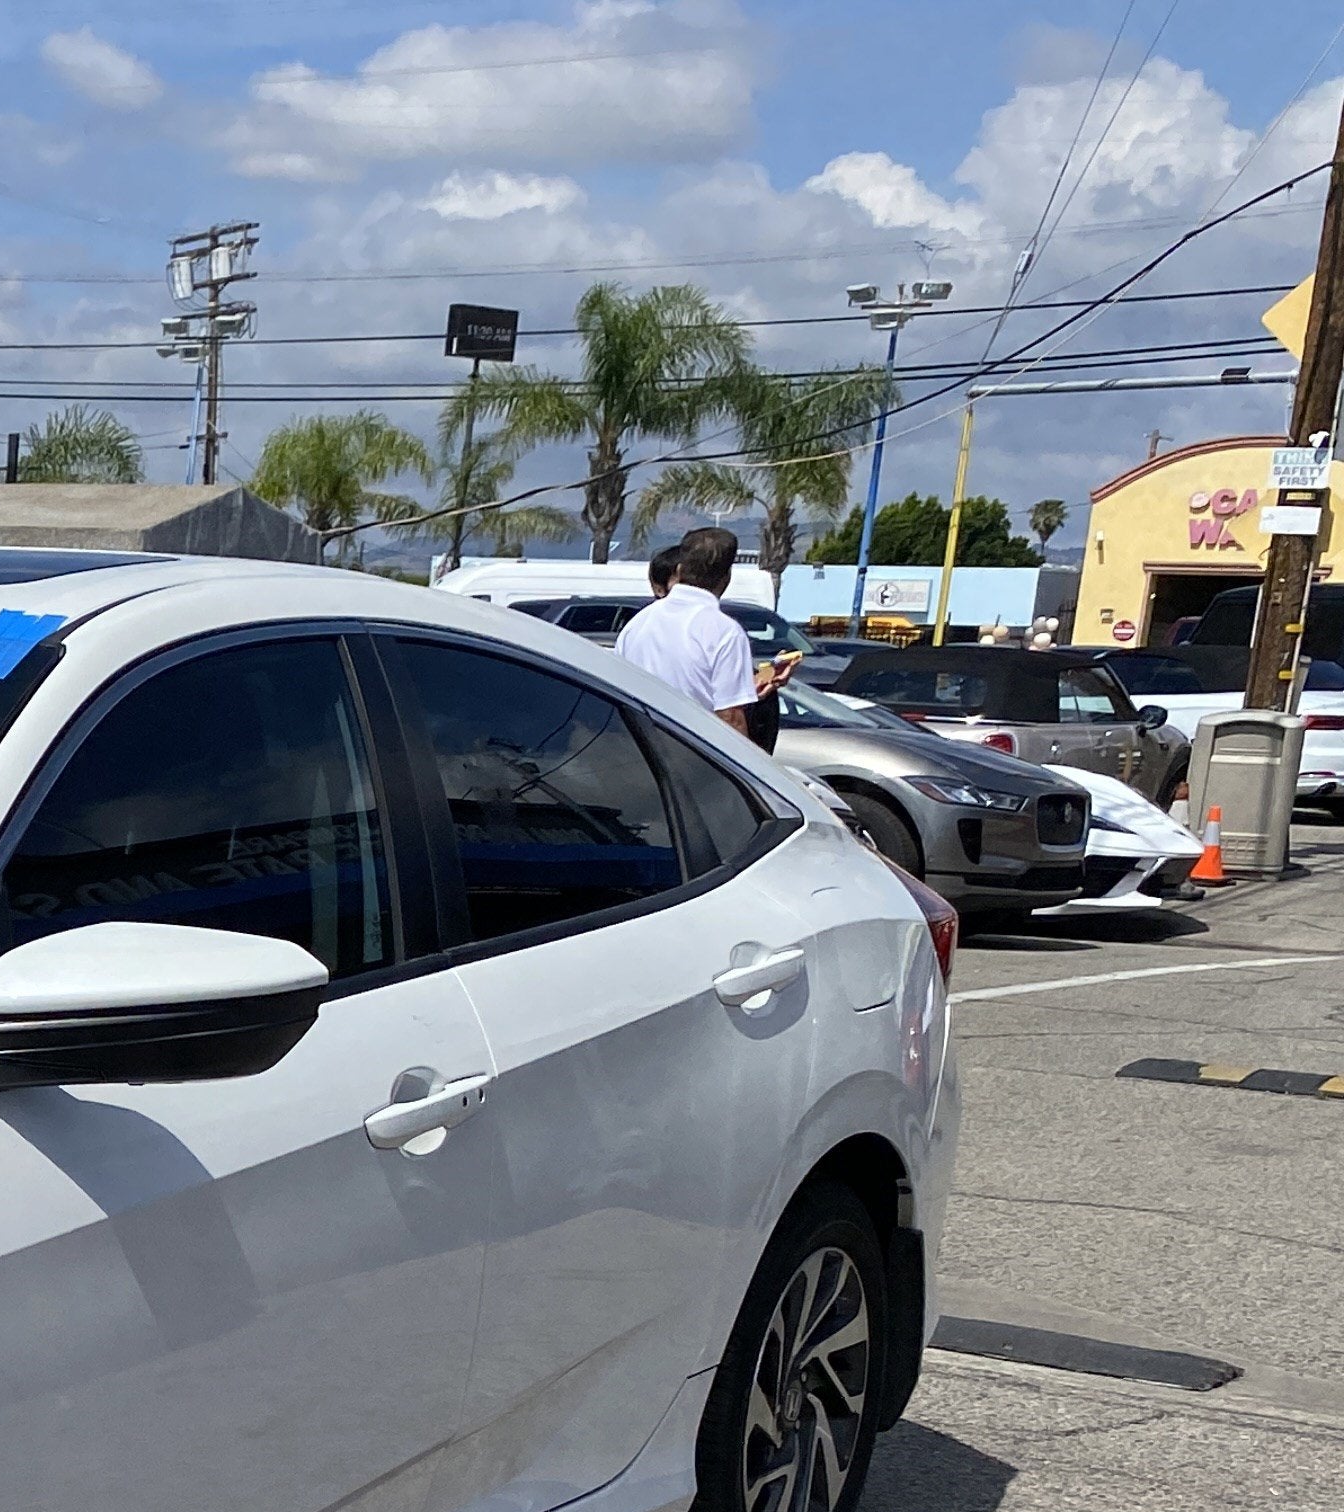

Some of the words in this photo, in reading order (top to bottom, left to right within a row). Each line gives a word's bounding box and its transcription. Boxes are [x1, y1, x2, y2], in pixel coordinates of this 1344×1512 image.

[1276, 451, 1326, 464] THIN
[1274, 466, 1326, 476] SAFETY
[1279, 477, 1317, 486] FIRST
